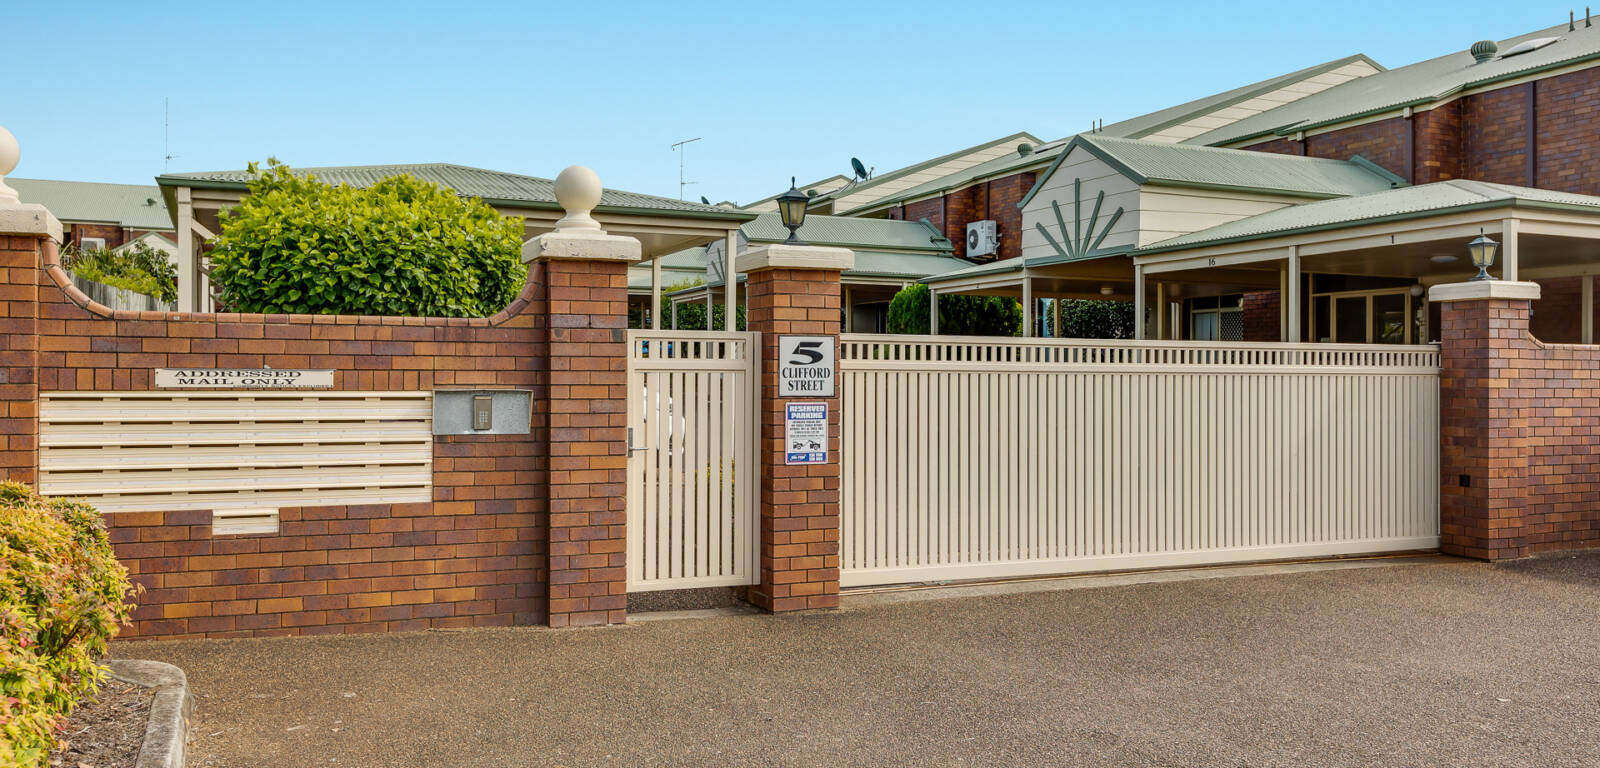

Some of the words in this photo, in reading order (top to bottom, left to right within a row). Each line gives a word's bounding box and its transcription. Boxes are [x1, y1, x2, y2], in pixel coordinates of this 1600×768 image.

[1208, 258, 1216, 266] 16
[788, 341, 824, 366] 5
[782, 367, 831, 379] CLIFFORD
[787, 379, 824, 391] STREET
